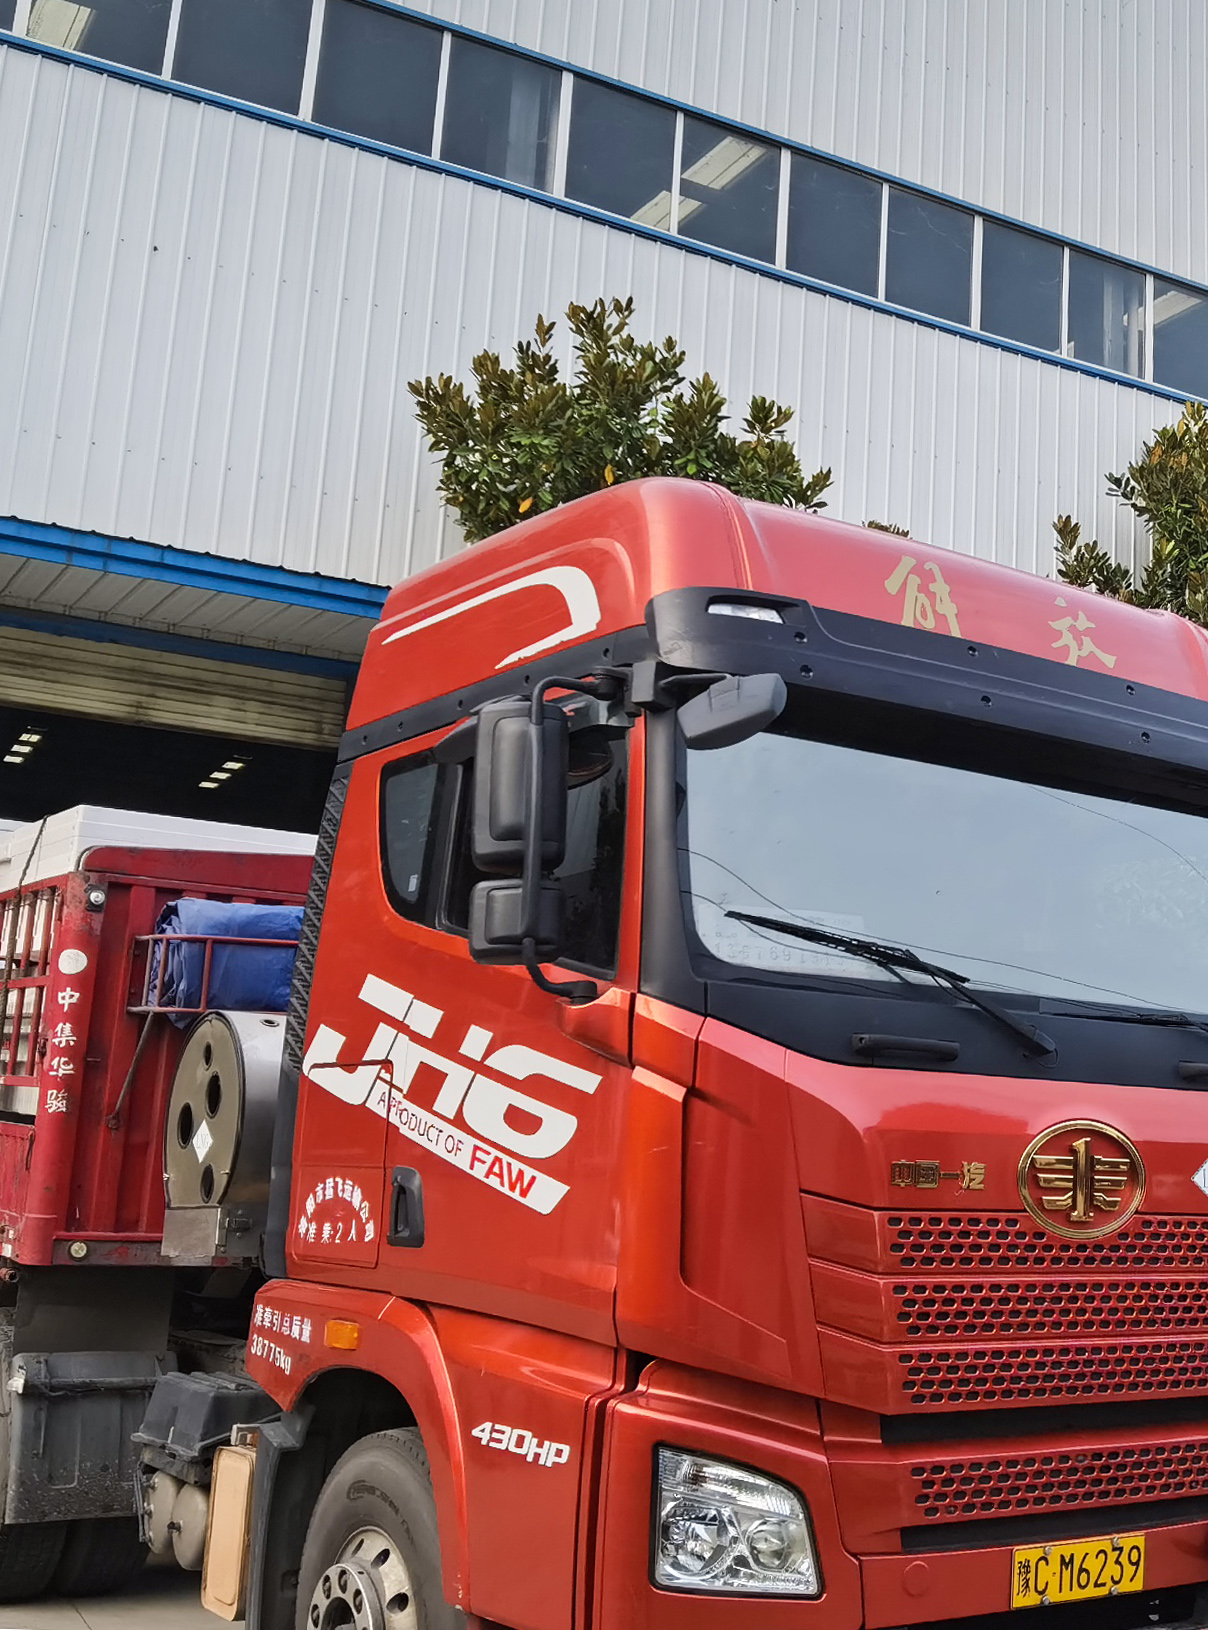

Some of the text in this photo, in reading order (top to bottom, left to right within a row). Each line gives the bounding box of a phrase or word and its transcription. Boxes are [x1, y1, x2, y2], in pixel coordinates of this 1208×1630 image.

[45, 987, 80, 1113] 中集华骏
[377, 1091, 537, 1199] A PRODUCT OF FAW
[890, 1159, 987, 1191] 中国一汽
[254, 1304, 312, 1344] 准牵引总质量
[250, 1333, 292, 1376] 38775kg
[471, 1421, 571, 1468] 430HP
